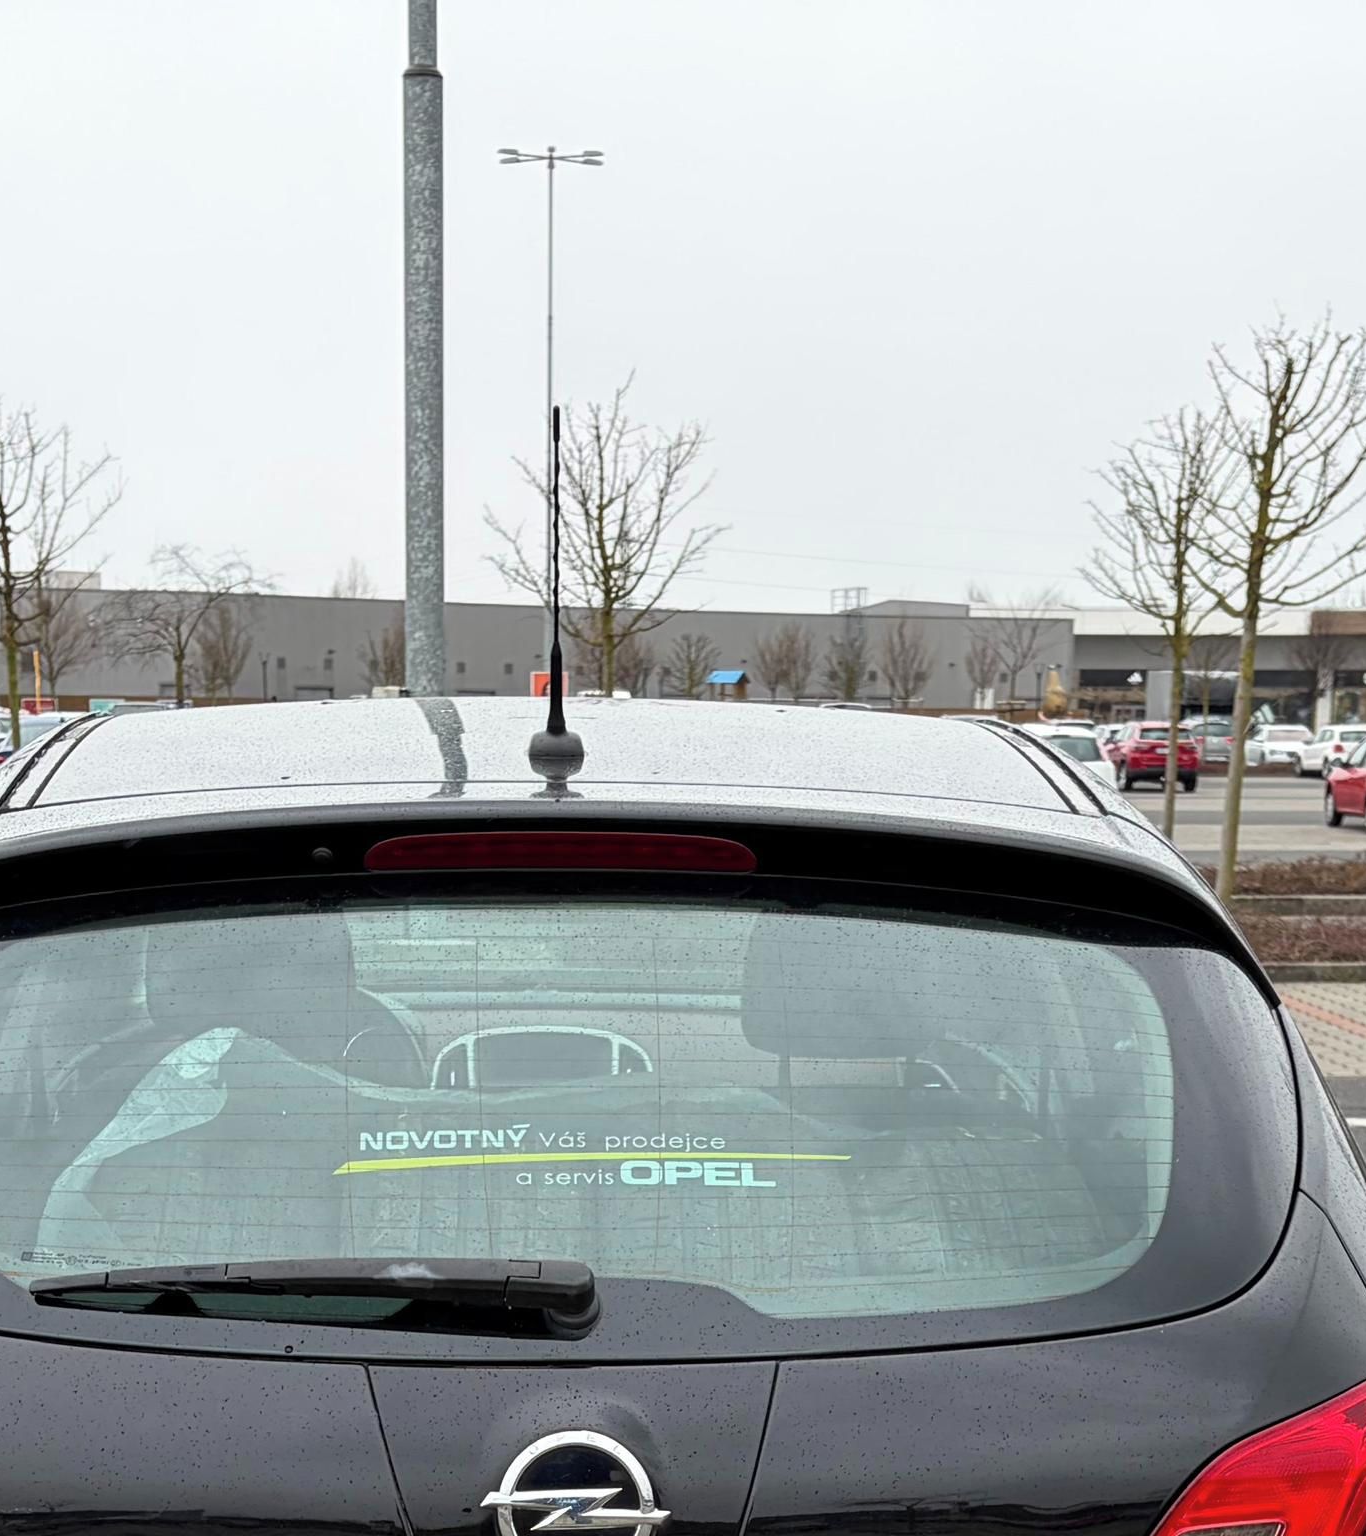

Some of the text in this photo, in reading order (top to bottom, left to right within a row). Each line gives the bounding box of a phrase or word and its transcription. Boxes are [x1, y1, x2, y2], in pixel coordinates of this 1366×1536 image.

[359, 1123, 726, 1152] NOVOTNÝ Váš prodejce
[516, 1160, 777, 1187] a servis OPEL
